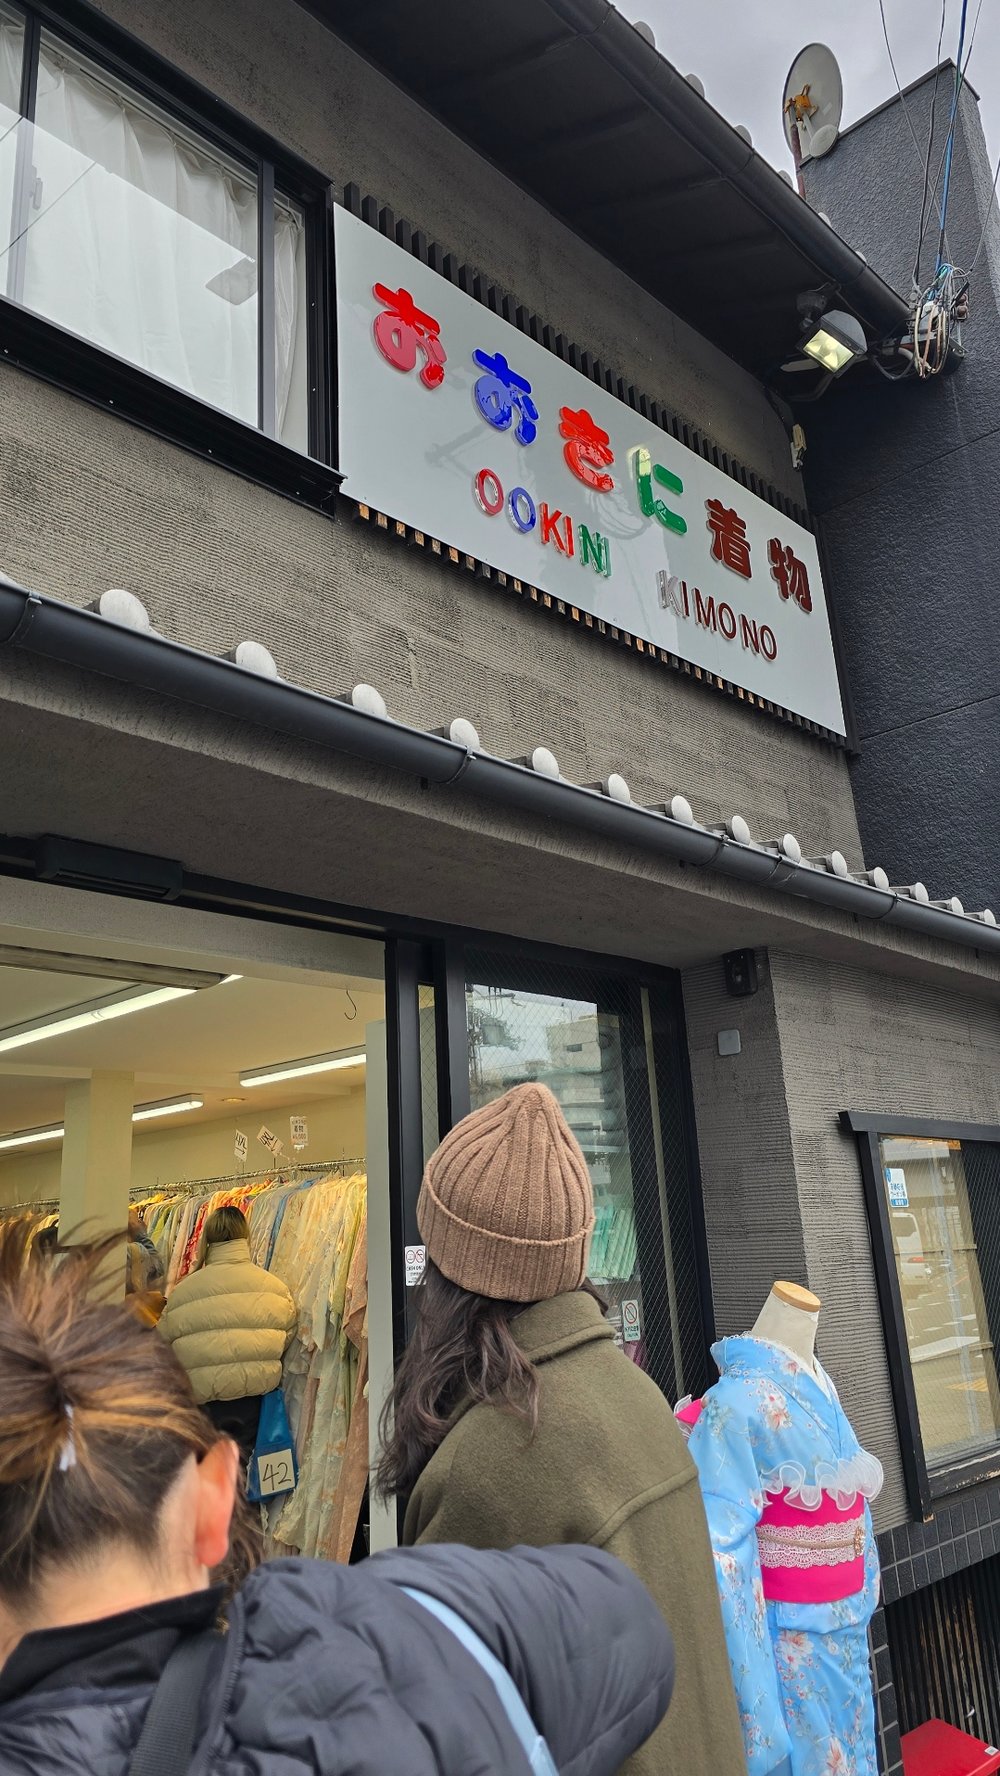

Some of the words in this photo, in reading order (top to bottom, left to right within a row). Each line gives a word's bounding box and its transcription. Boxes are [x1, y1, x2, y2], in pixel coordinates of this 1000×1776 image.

[474, 468, 611, 577] OOKINI
[657, 569, 777, 661] KIMONO
[262, 1462, 292, 1491] 42
